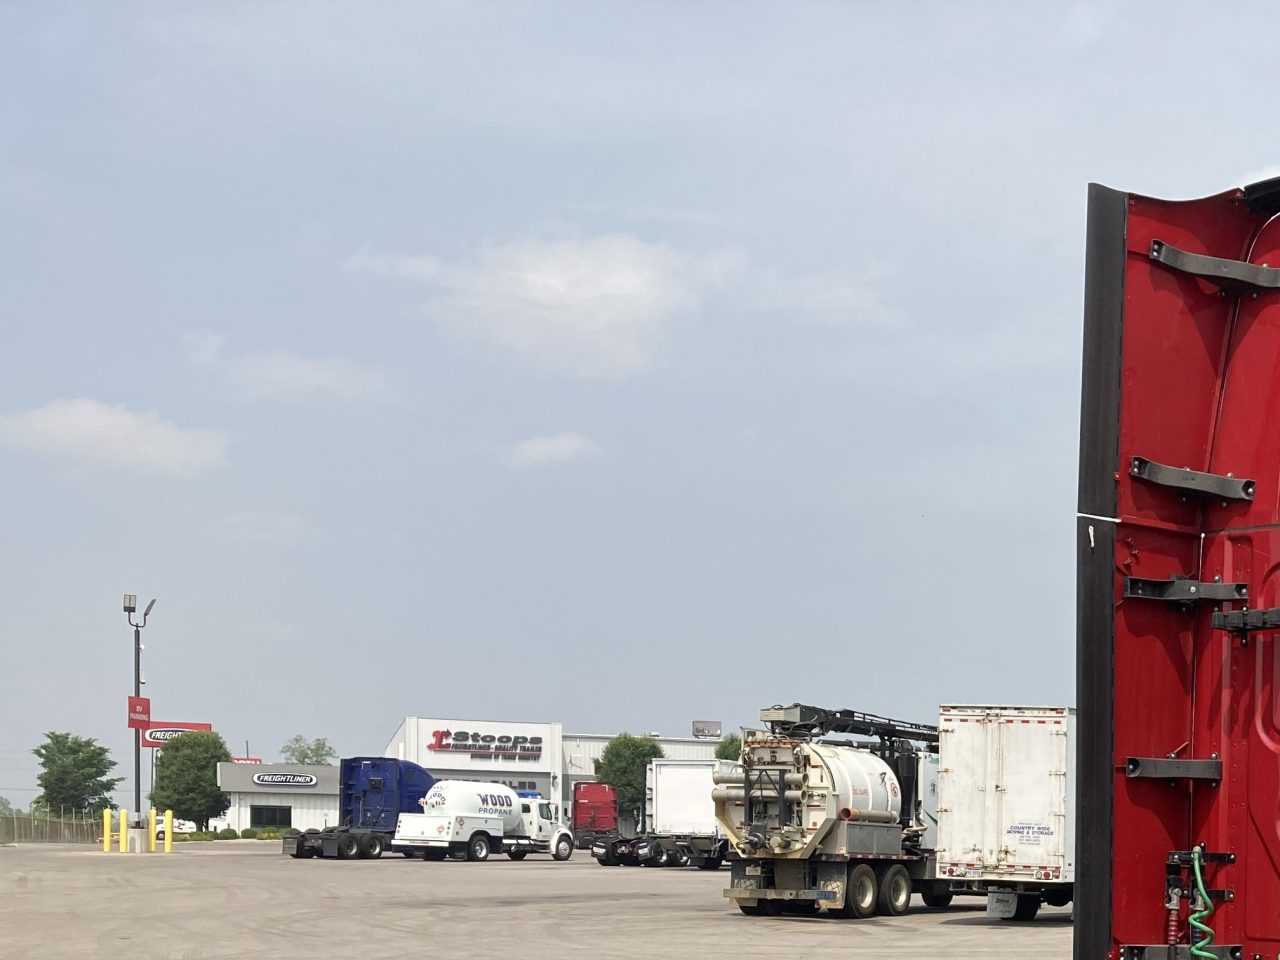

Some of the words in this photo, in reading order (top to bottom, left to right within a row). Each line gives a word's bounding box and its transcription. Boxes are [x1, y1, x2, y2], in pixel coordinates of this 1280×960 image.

[451, 731, 542, 747] Stoops
[259, 774, 311, 783] FREIGHTLINER
[477, 794, 513, 807] WOOD
[478, 807, 513, 815] PROPANE
